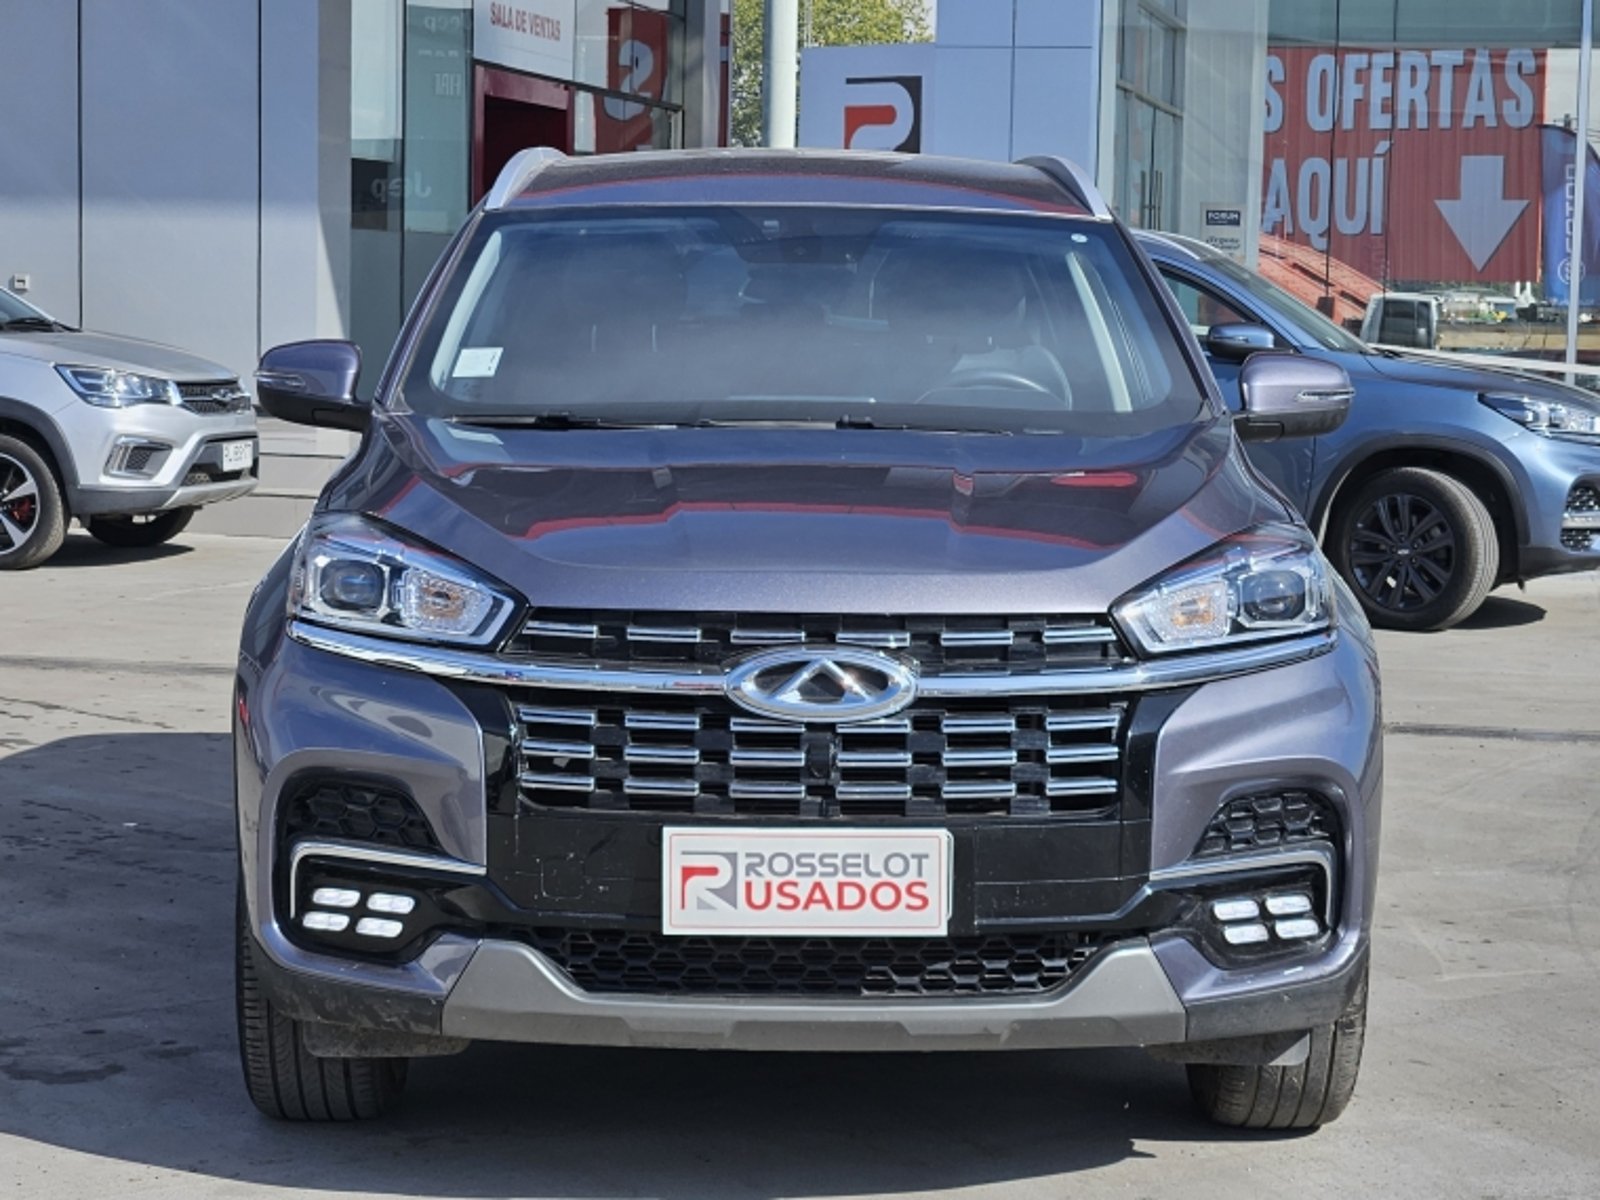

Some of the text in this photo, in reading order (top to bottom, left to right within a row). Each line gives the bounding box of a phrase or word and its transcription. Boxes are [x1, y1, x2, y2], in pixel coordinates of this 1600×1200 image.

[490, 2, 561, 41] SALA DE VENTAS
[1306, 48, 1536, 132] OFERTAS
[1261, 141, 1393, 251] AQUÍ
[745, 852, 929, 878] ROSSELOT
[745, 881, 929, 911] USADOS
